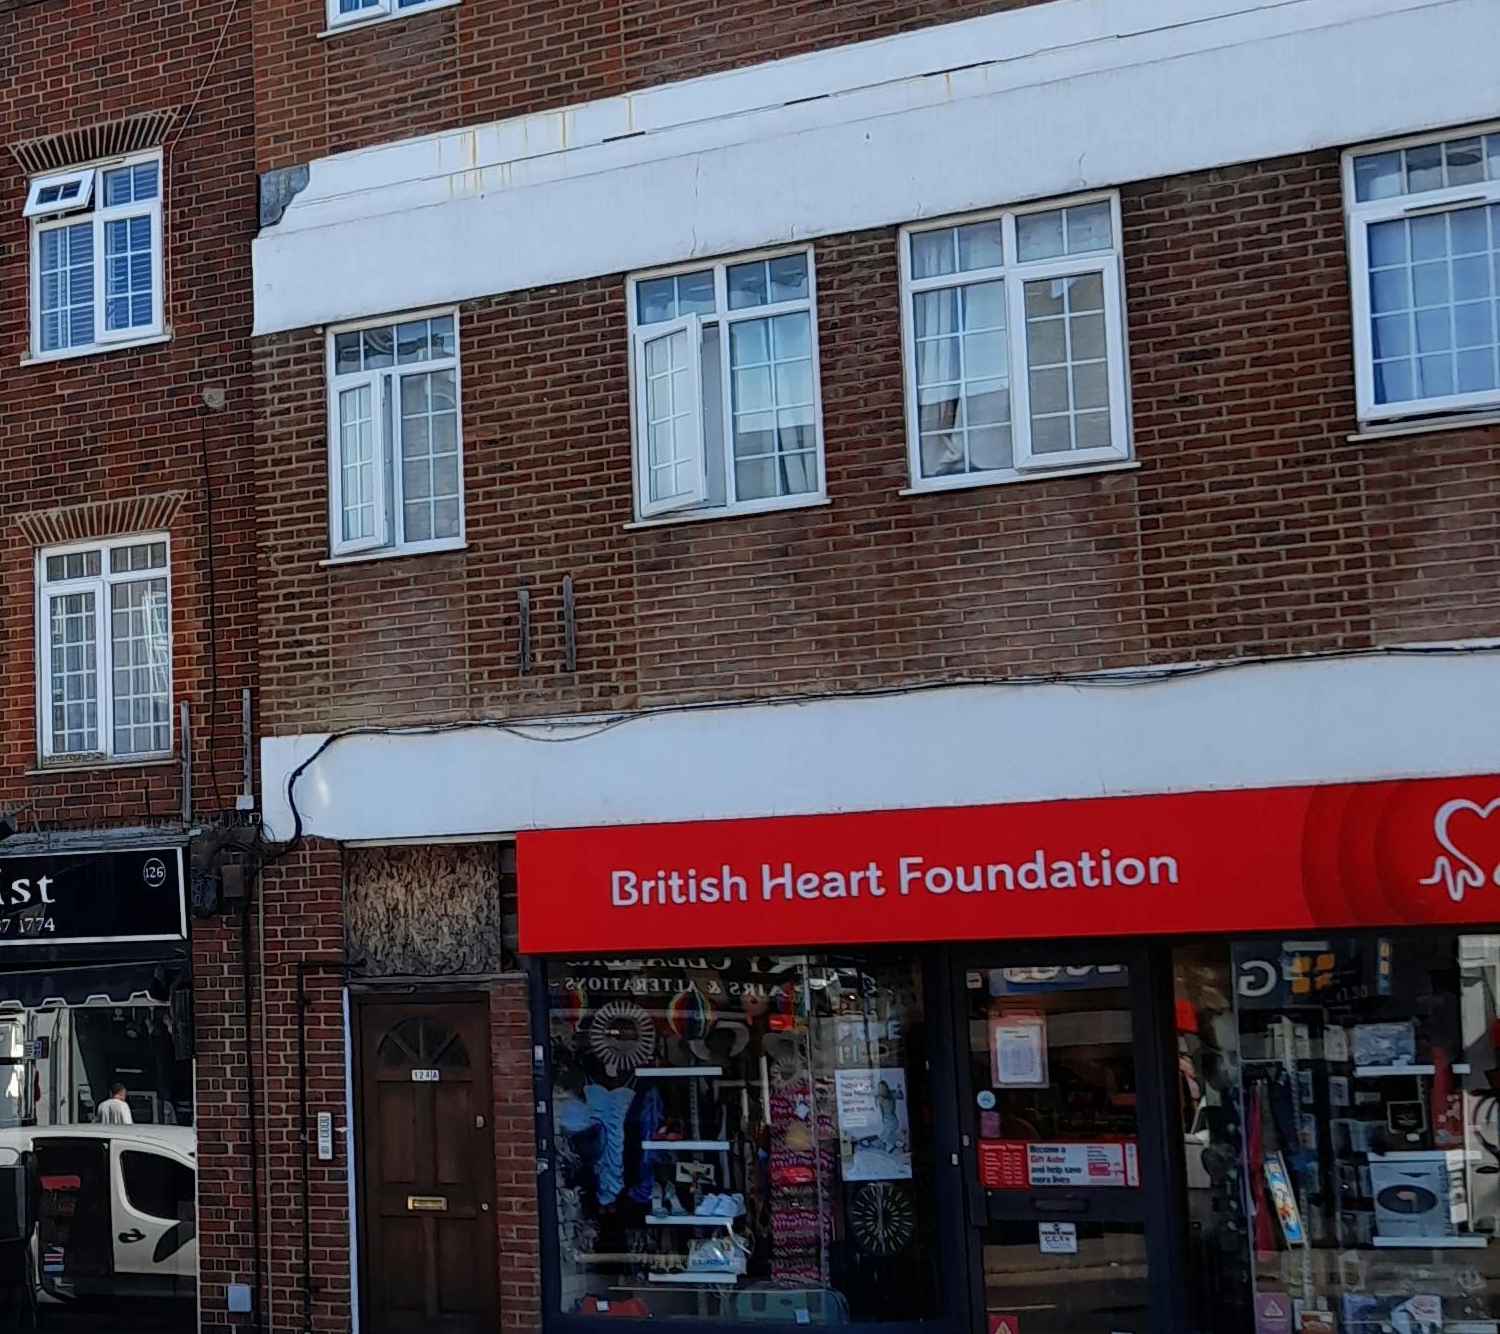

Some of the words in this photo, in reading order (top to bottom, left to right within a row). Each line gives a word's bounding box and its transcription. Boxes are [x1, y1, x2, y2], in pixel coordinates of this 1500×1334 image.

[145, 866, 164, 879] 126
[611, 864, 747, 907] British
[761, 860, 887, 901] Heart
[900, 848, 1180, 896] Foundation
[18, 917, 56, 933] 1774
